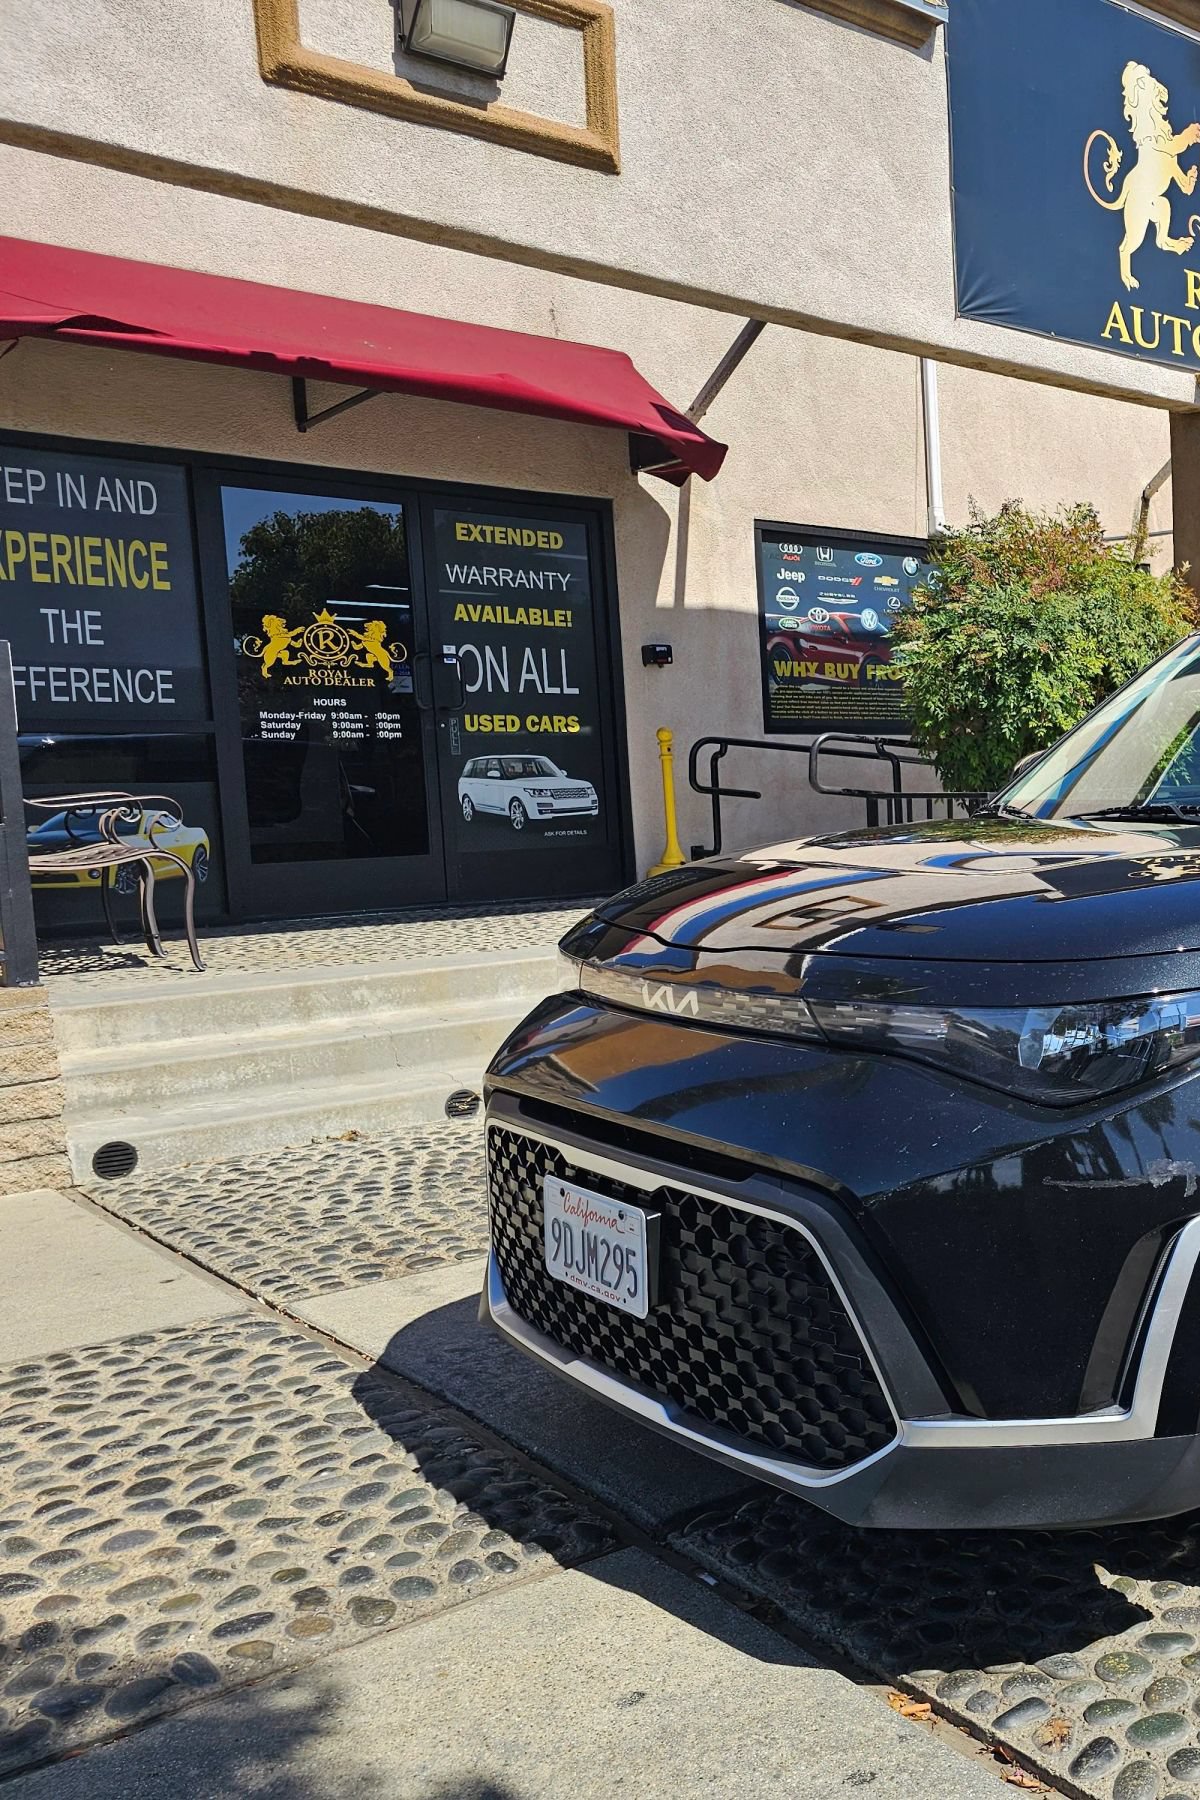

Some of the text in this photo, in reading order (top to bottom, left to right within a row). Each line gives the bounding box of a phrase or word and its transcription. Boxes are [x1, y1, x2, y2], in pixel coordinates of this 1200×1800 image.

[0, 466, 158, 516] EP IN AND
[455, 522, 564, 550] EXTENDED
[858, 555, 878, 566] Ford
[445, 563, 571, 592] WARRANTY
[776, 567, 806, 583] Jeep
[454, 603, 573, 628] AVAILABLE!
[39, 608, 105, 646] THE
[308, 669, 351, 679] ROYAL
[456, 643, 580, 695] ON ALL
[774, 660, 820, 678] WHY
[824, 662, 861, 680] BUY
[283, 676, 376, 688] AUTO DEALER
[313, 698, 347, 707] HOURS
[259, 711, 327, 721] Monday-Friday
[330, 712, 363, 720] 9:00am
[260, 721, 302, 731] Saturday
[332, 721, 364, 729] 9:00am
[464, 714, 581, 733] USED CARS
[261, 731, 296, 740] Sunday
[332, 731, 364, 739] 9:00am
[641, 983, 700, 1017] KIA
[563, 1191, 626, 1234] California
[551, 1217, 638, 1298] 9DJM295
[570, 1274, 622, 1303] dmv.ca.gov
